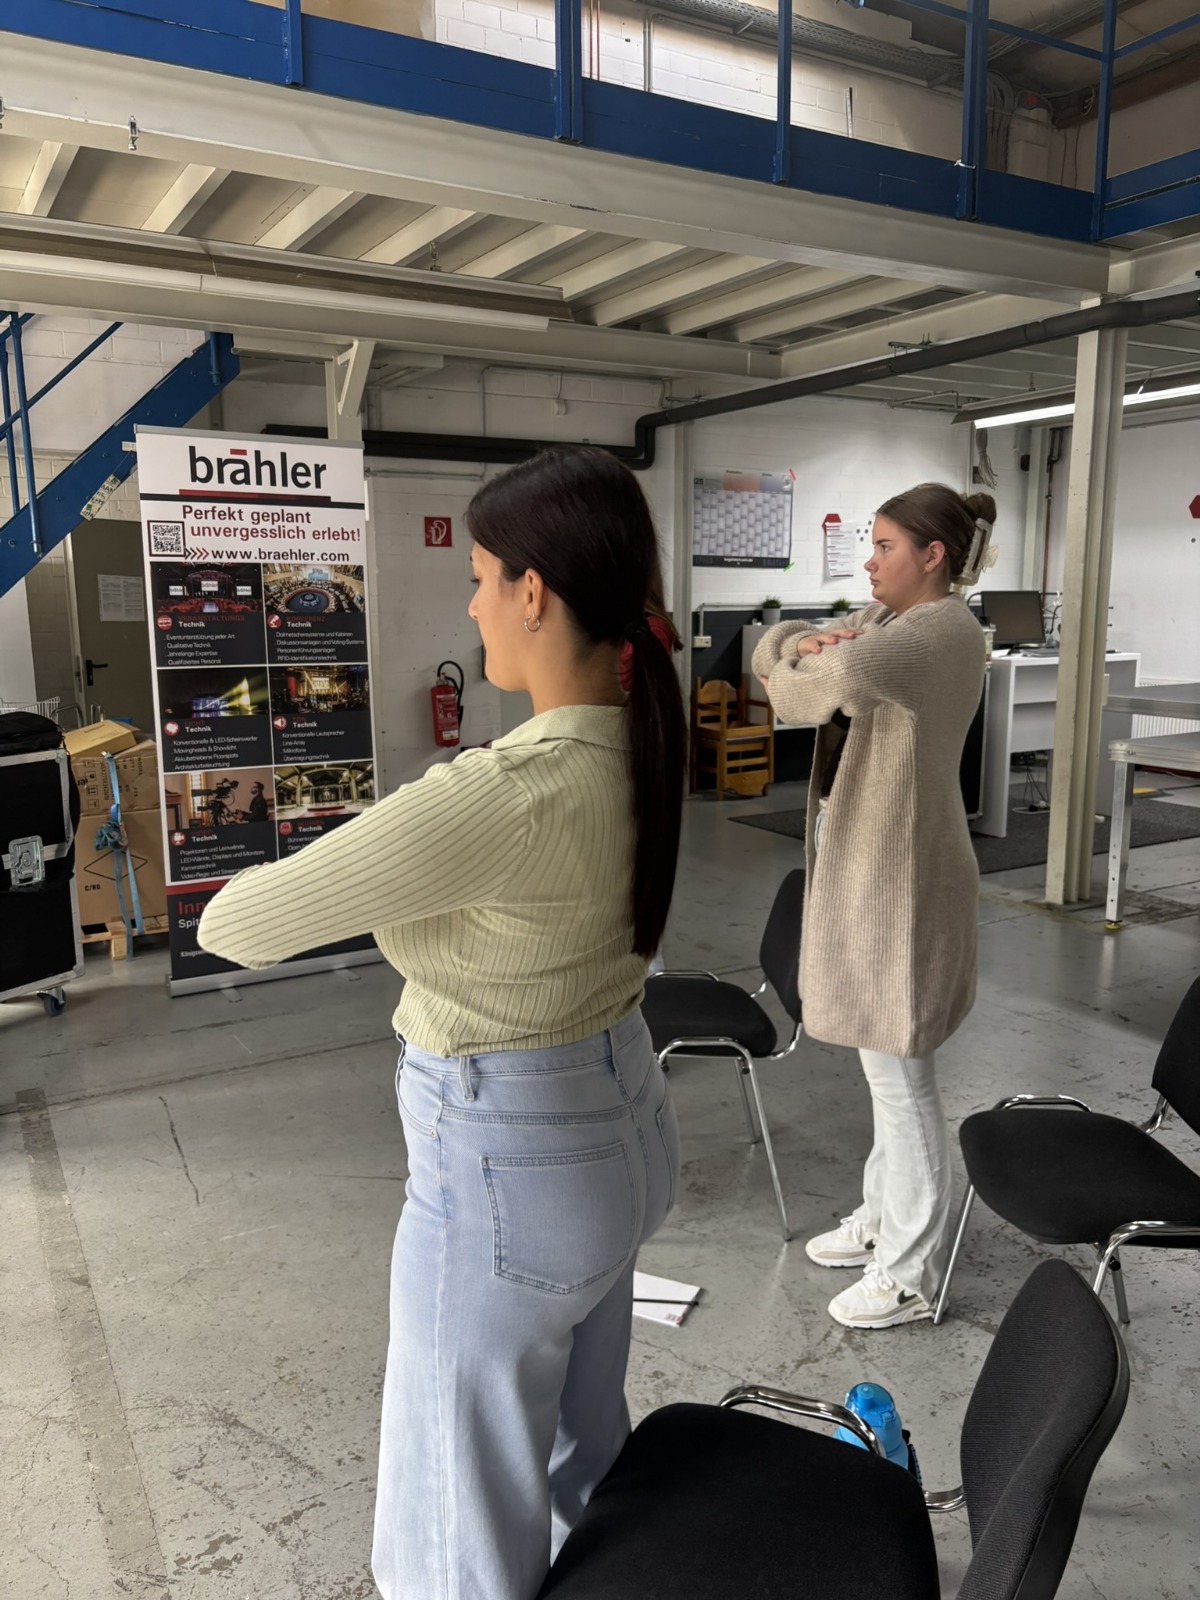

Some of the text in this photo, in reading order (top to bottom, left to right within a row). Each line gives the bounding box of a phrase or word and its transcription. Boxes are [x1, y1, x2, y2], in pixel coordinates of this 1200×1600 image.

[182, 505, 312, 526] Perfekt geplant
[191, 524, 361, 542] unvergesslich erlebt!
[211, 548, 350, 562] www.braehler.com
[192, 834, 218, 842] Technik
[179, 848, 208, 856] Projektoren
[178, 900, 205, 915] Inn
[178, 917, 201, 929] Spit
